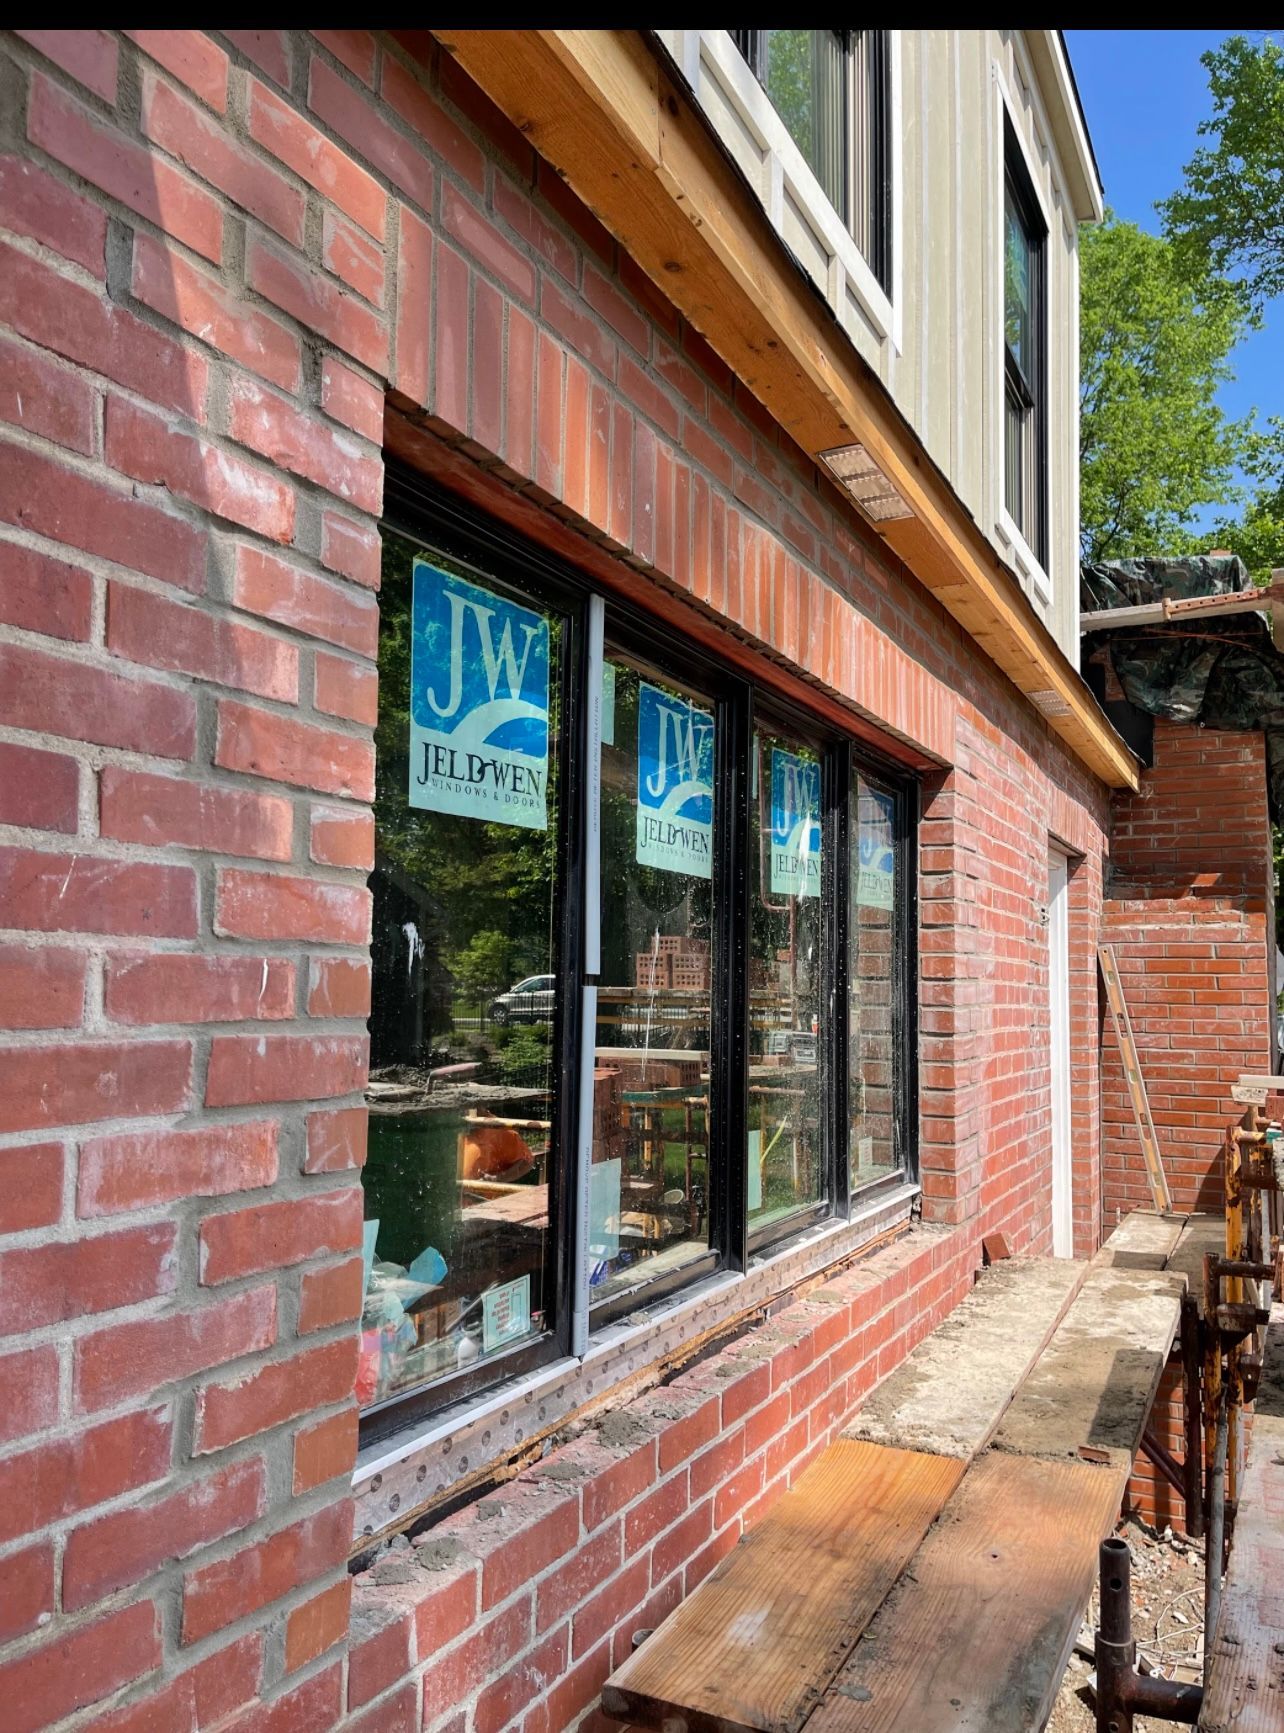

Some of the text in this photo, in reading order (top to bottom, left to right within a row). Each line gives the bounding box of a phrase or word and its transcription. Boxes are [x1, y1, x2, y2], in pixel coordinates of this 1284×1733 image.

[427, 589, 539, 718] JW
[432, 778, 488, 798] WINDOWS
[505, 794, 541, 809] DOORS
